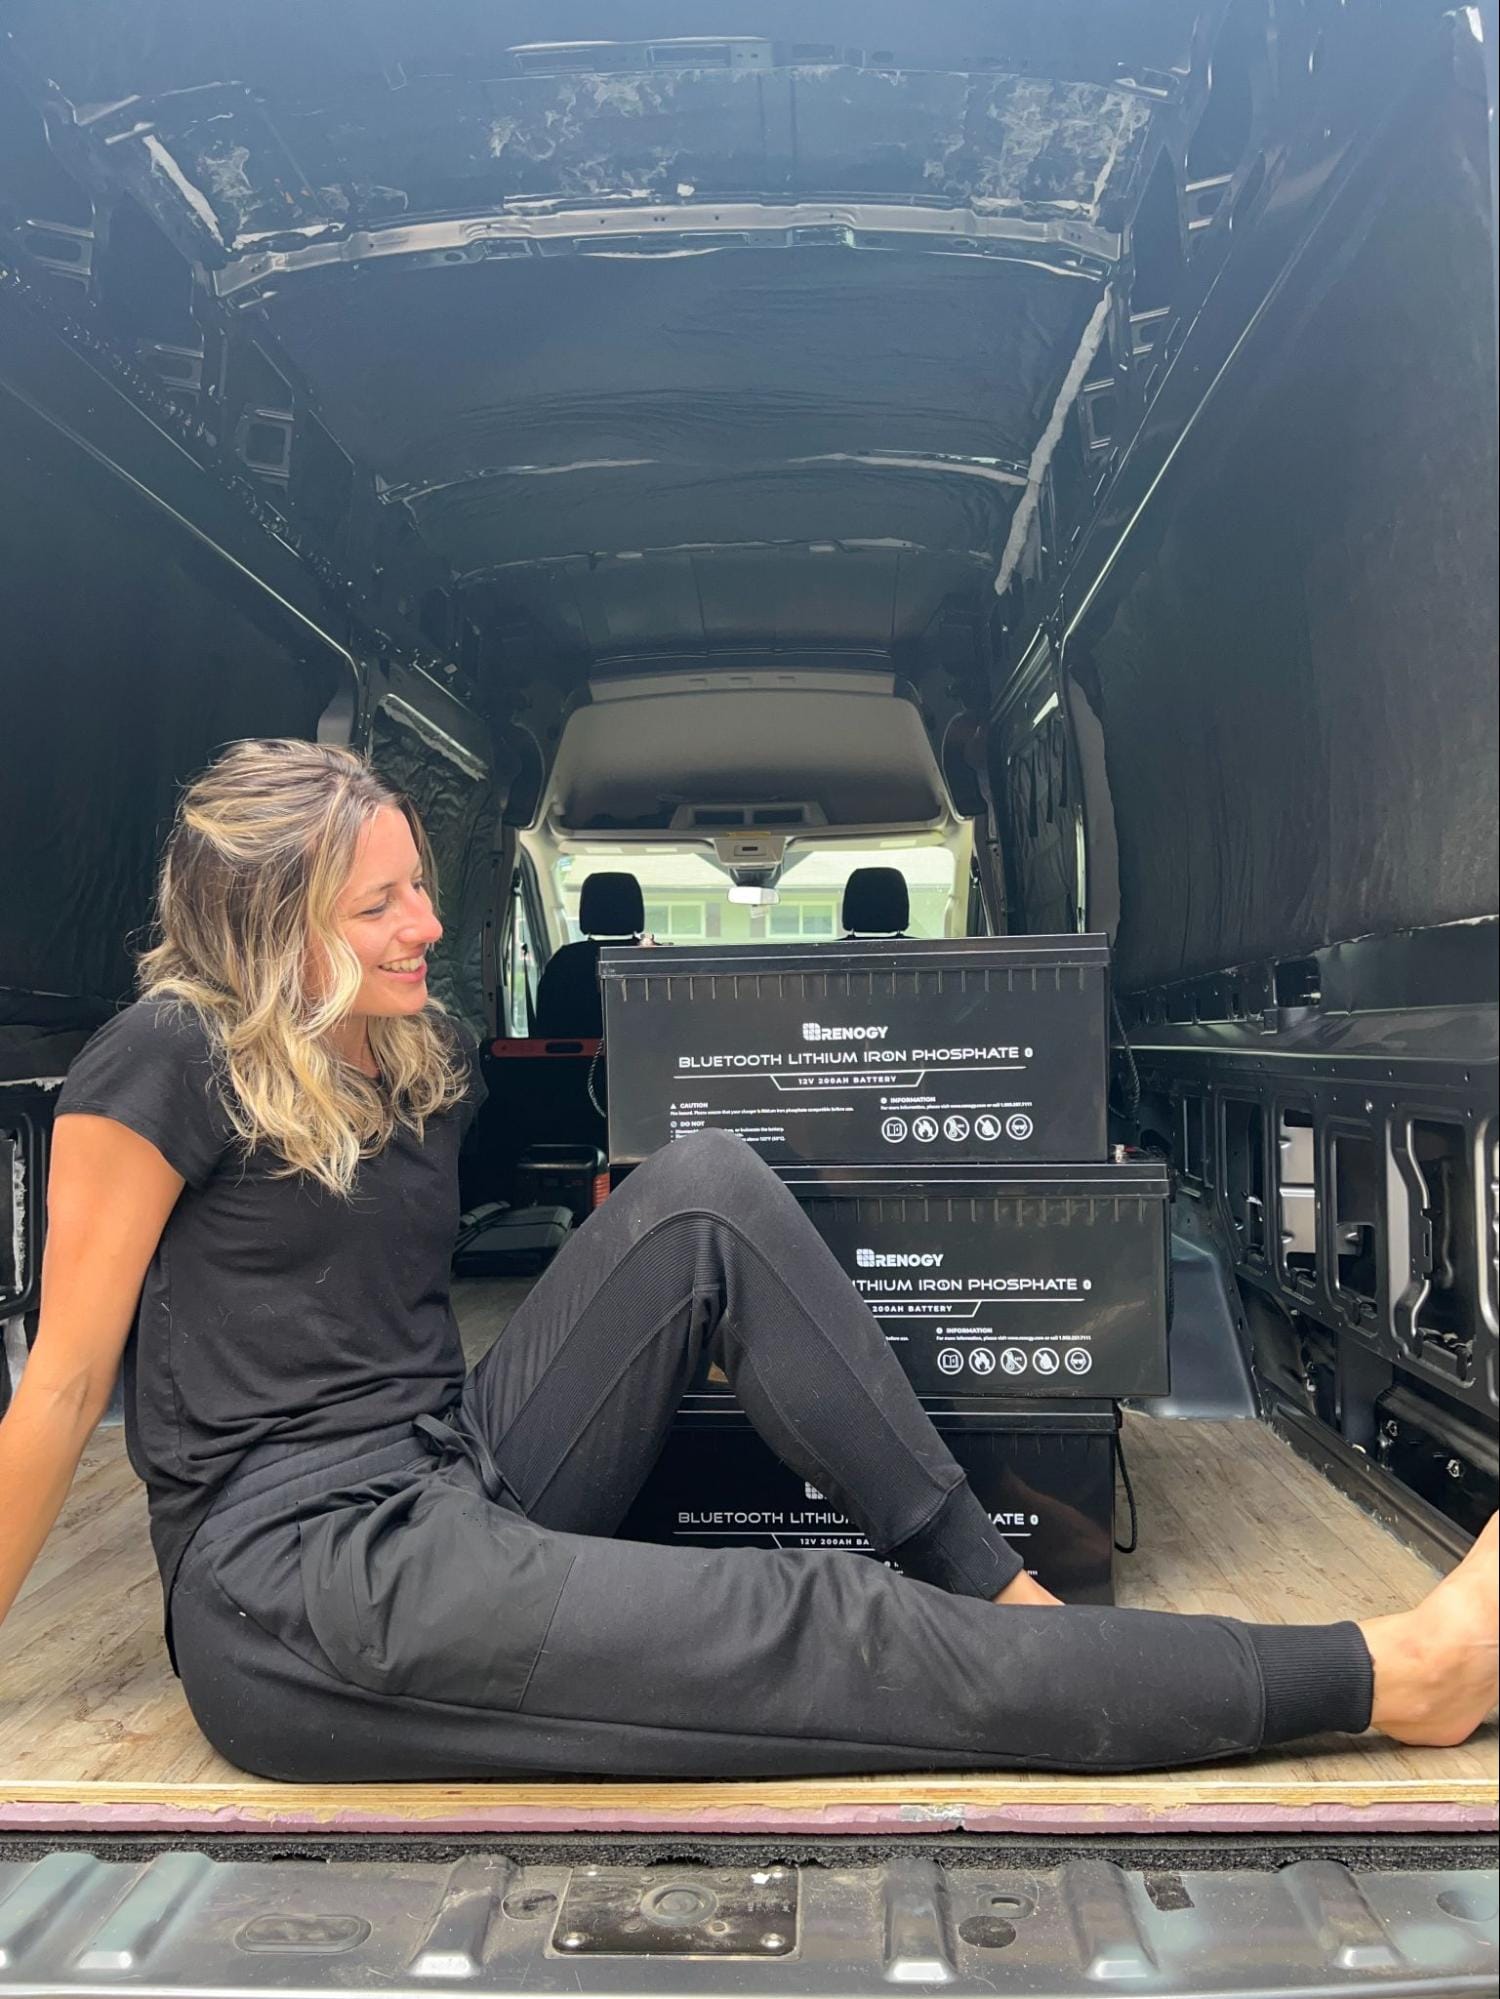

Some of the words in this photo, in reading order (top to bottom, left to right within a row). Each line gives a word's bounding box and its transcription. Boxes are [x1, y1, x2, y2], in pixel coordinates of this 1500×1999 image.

[821, 1026, 889, 1041] RENOGY
[678, 1054, 782, 1068] BLUETOOTH
[788, 1051, 858, 1065] LITHIUM
[864, 1050, 907, 1063] IRON
[912, 1047, 1019, 1061] PHOSPHATE
[818, 1077, 849, 1085] 200AH
[853, 1076, 897, 1084] BATTERY
[890, 1096, 936, 1104] INFORMATION
[875, 1253, 944, 1268] RENOGY
[852, 1278, 913, 1292] THIUM
[918, 1278, 962, 1291] IRON
[968, 1278, 1078, 1291] PHOSPHATE
[872, 1305, 904, 1313] 200AH
[908, 1305, 953, 1313] BATTERY
[678, 1512, 783, 1524] BLUETOOTH
[789, 1512, 849, 1524] LITHIU
